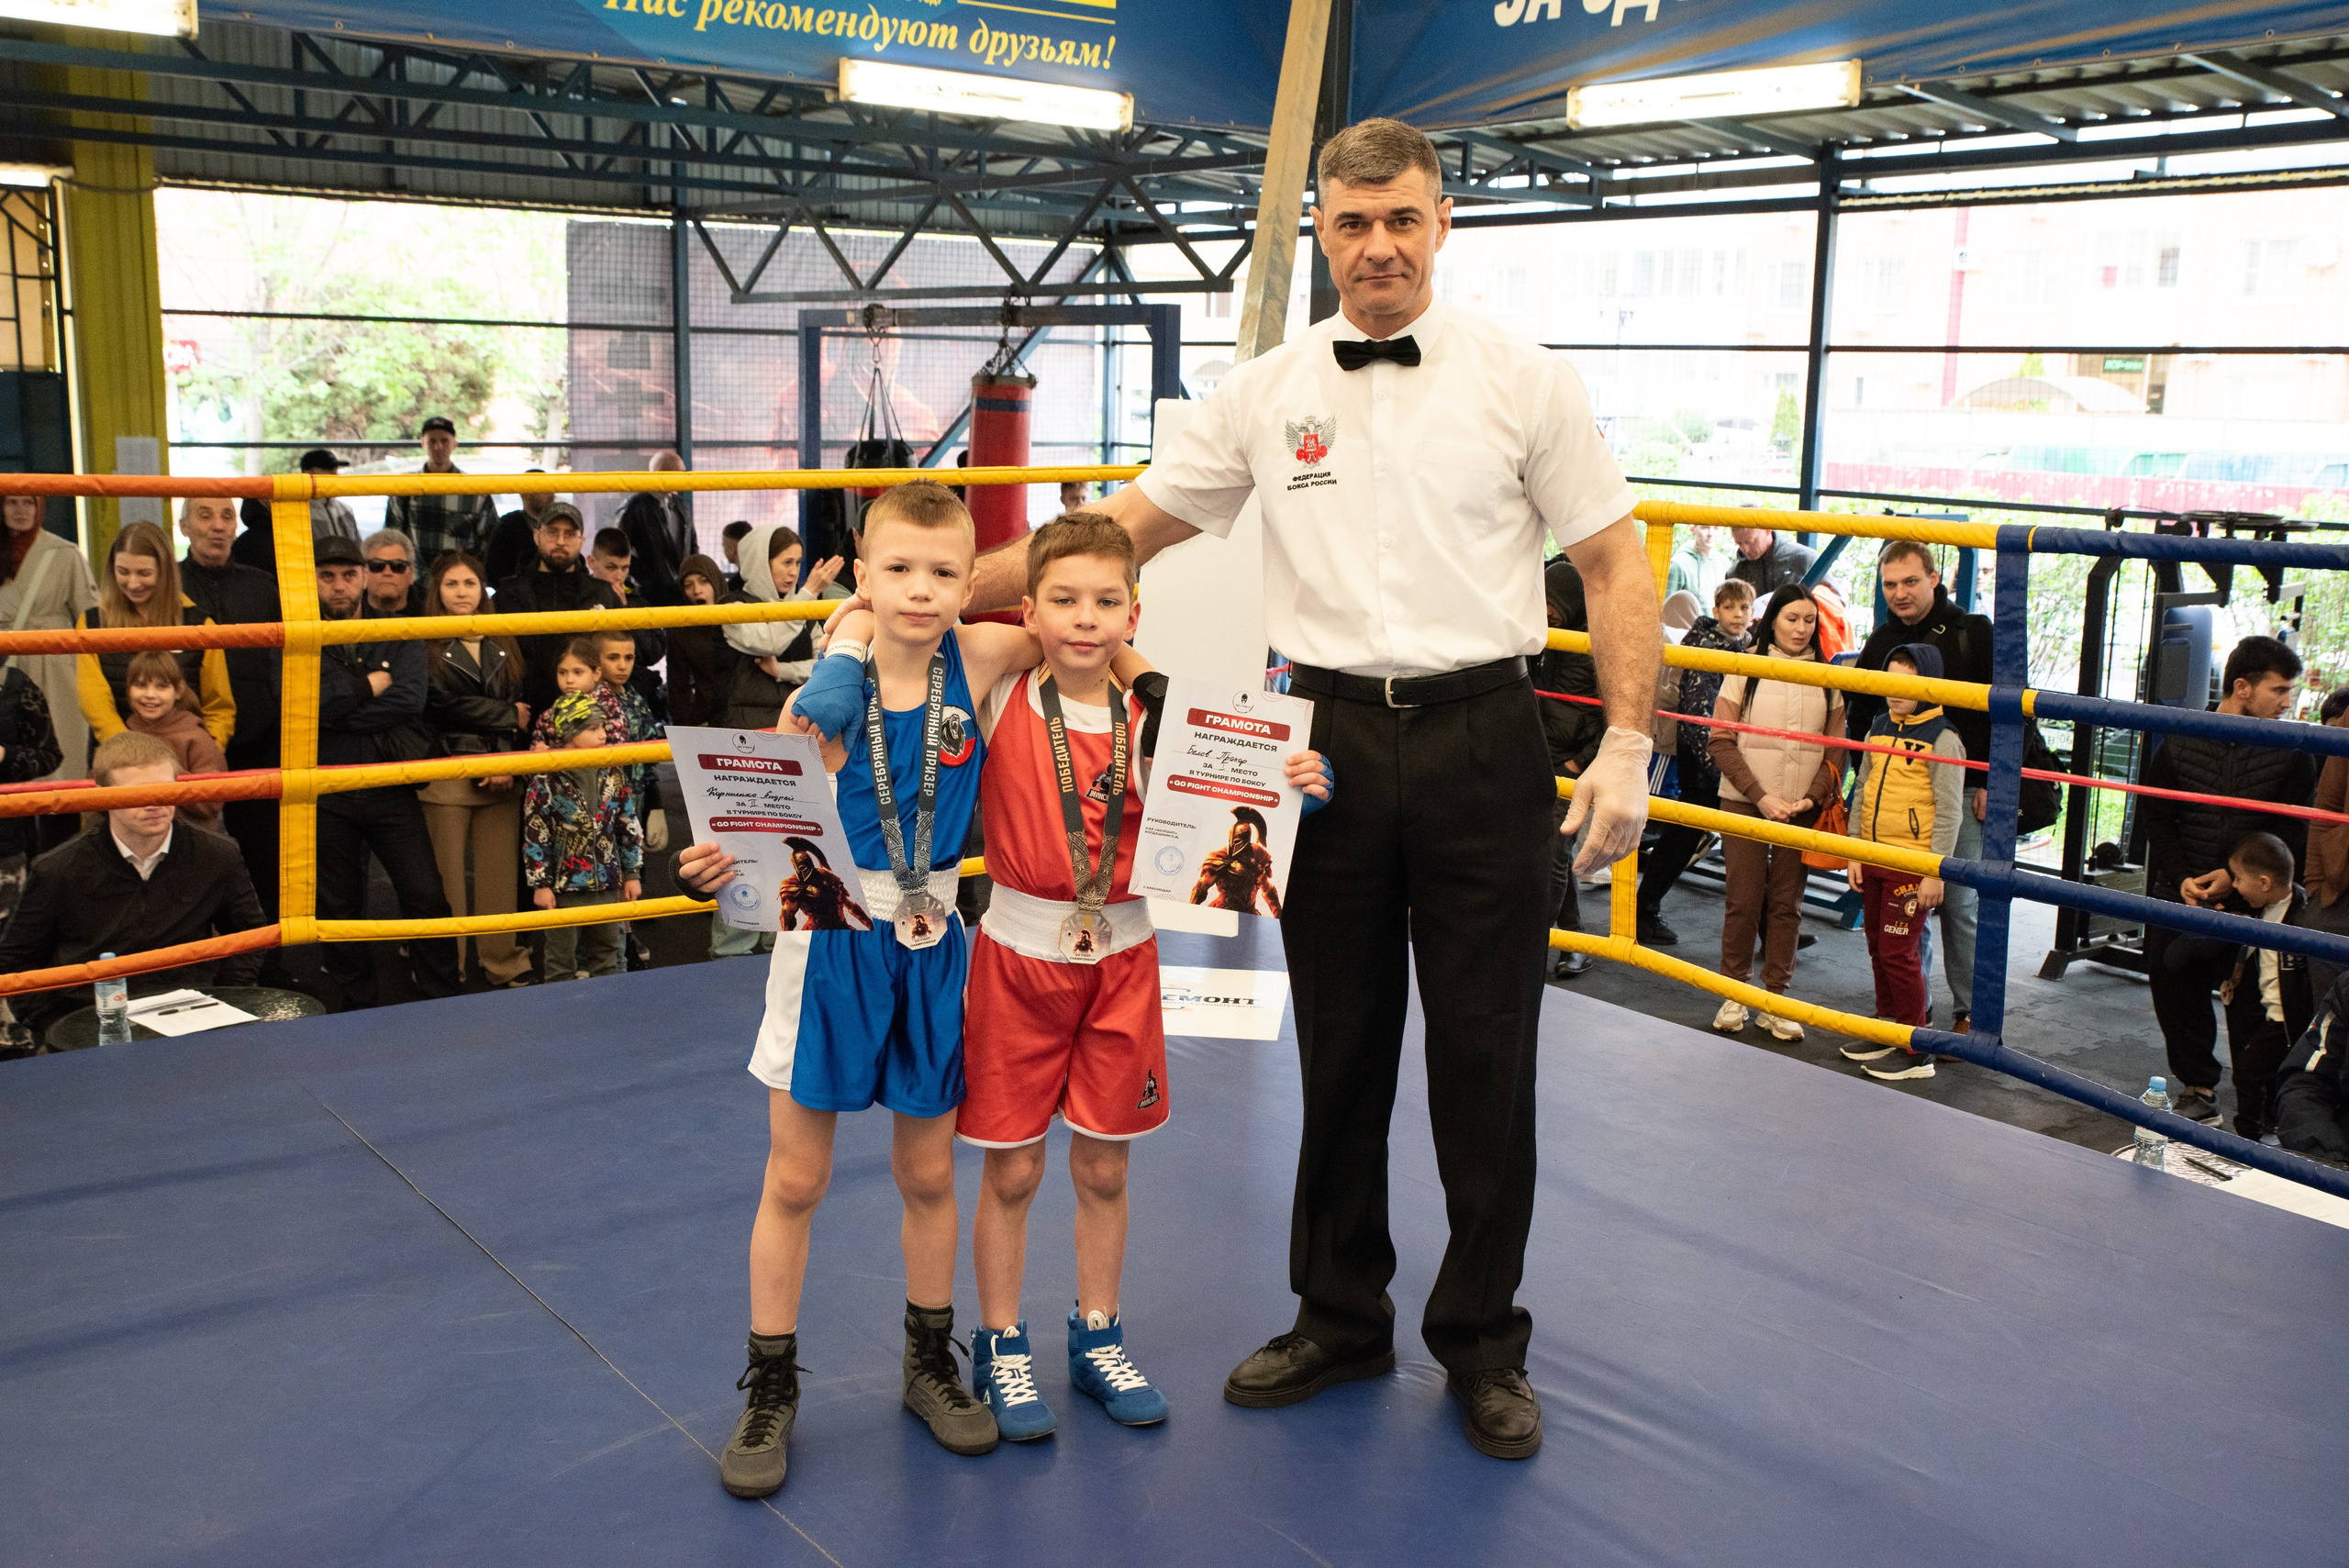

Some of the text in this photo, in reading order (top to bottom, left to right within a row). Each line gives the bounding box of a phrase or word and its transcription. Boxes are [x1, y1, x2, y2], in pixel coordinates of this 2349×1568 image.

[694, 0, 958, 52] рекомендуют
[969, 17, 1117, 70] друзьям!
[1287, 479, 1338, 491] БОКСА РОССИИ
[1292, 472, 1331, 482] ФЕДЕРАЦИЯ
[923, 666, 943, 797] СЕРЕБРЯНЫЙ ПРИЗЕР
[1205, 714, 1272, 735] ГРАМОТА
[1194, 731, 1277, 752] НАГРАЖДАЕТСЯ
[716, 758, 783, 771] ГРАМОТА
[867, 723, 892, 806] СЕРЕБРЯНЫЙ
[1050, 717, 1074, 793] ПОБЕДИТЕЛЬ
[1112, 721, 1126, 796] ПОБЕДИТЕЛЬ
[714, 774, 796, 786] НАГРАЖДАЕТСЯ
[1196, 771, 1229, 782] ТУРНИРЕ
[1241, 779, 1266, 787] БОКСУ
[1230, 767, 1258, 777] МЕСТО
[1187, 783, 1211, 793] FIGHT
[1211, 786, 1274, 802] CHAMPIONSHIP
[755, 821, 817, 831] CHAMPIONSHIP
